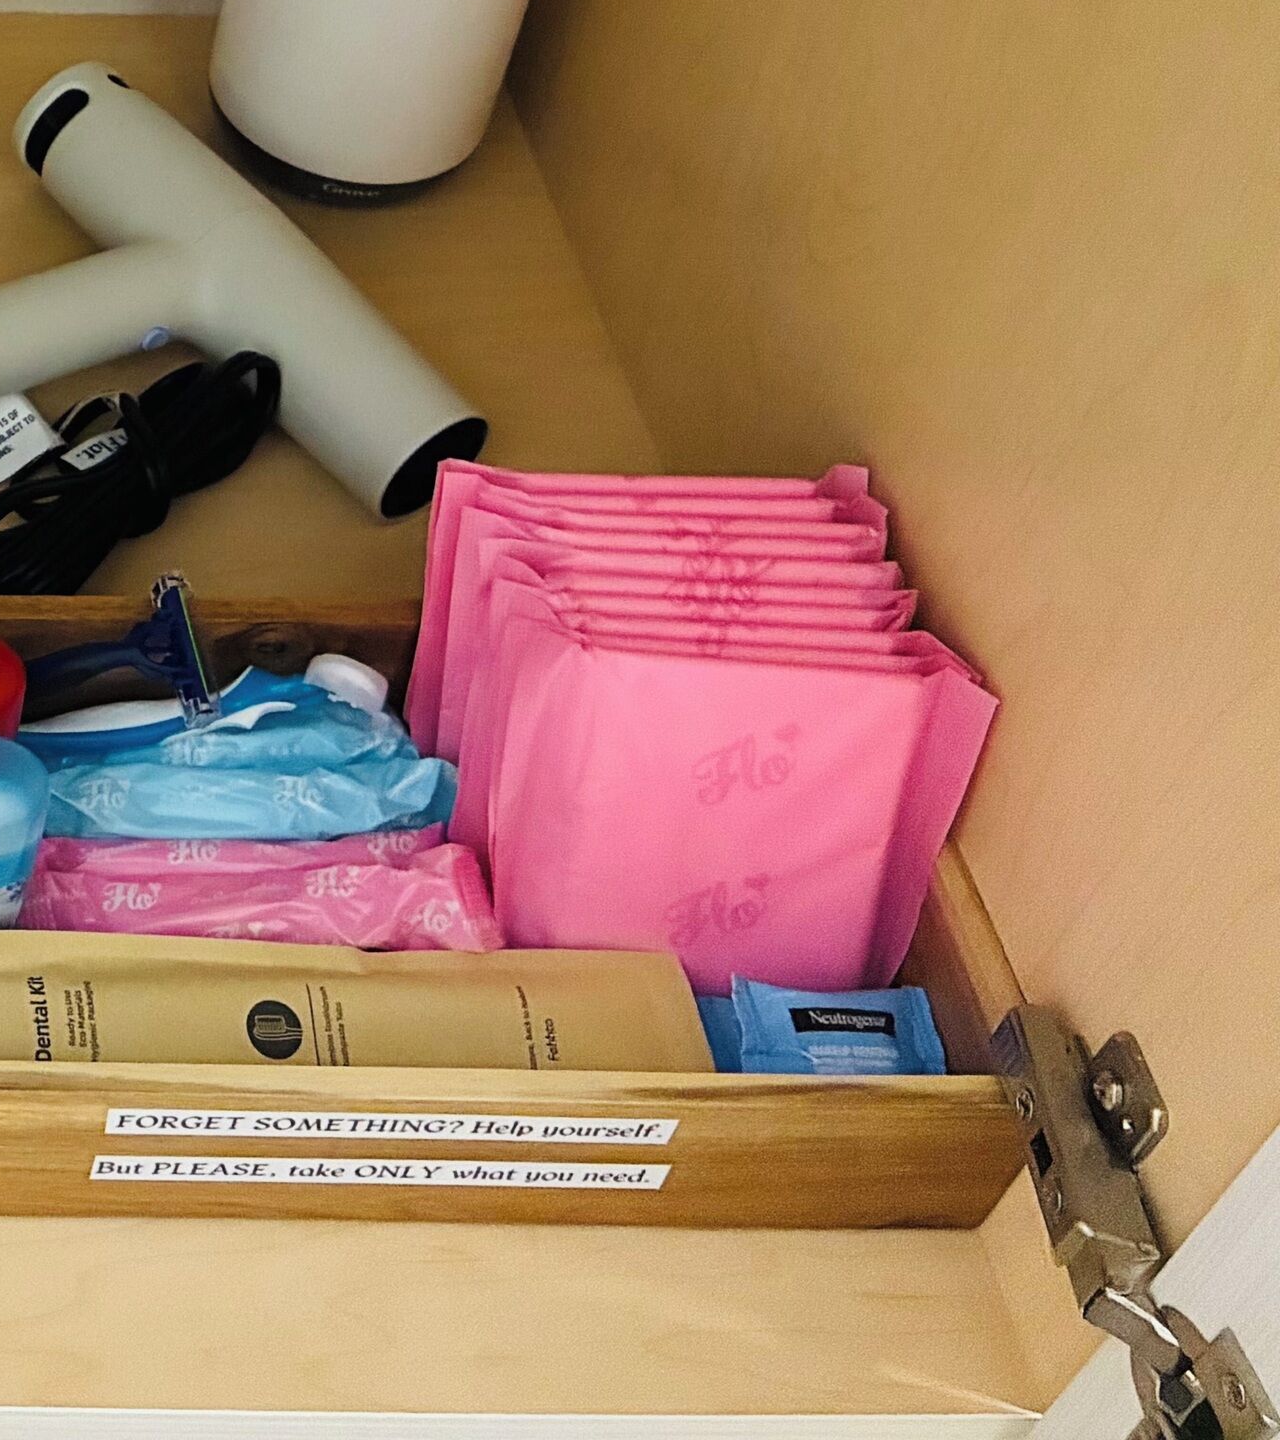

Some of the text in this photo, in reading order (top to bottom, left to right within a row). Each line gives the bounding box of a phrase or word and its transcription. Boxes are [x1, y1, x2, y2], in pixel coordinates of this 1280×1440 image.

[8, 409, 19, 422] OF
[24, 415, 36, 427] TO
[693, 734, 791, 806] Flo
[78, 778, 127, 810] Flo
[102, 883, 157, 911] Flo
[667, 882, 768, 948] Flo
[27, 976, 52, 1062] Dental Kit
[116, 1114, 664, 1139] FORGET SOMETHING? Help yourself.
[96, 1161, 650, 1183] But PLEASE, take ONLY what you need.
